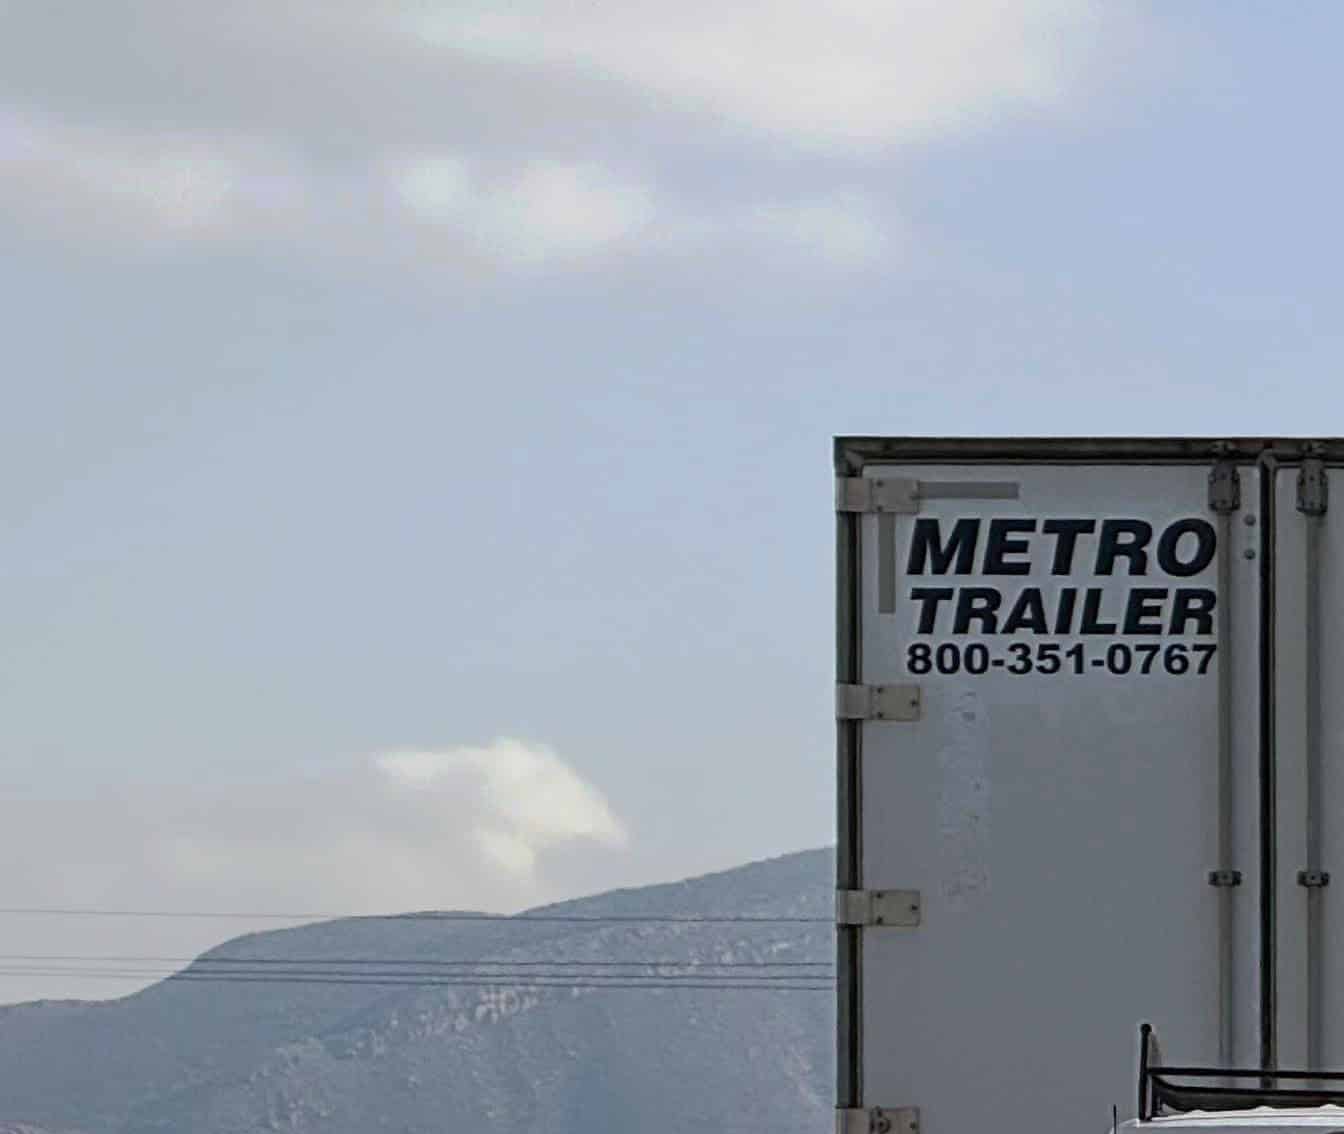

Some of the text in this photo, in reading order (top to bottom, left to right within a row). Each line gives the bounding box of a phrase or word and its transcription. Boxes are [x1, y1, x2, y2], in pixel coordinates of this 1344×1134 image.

[906, 517, 1217, 577] METRO
[910, 587, 1217, 635] TRAILER
[906, 643, 1217, 675] 800-351-0767
